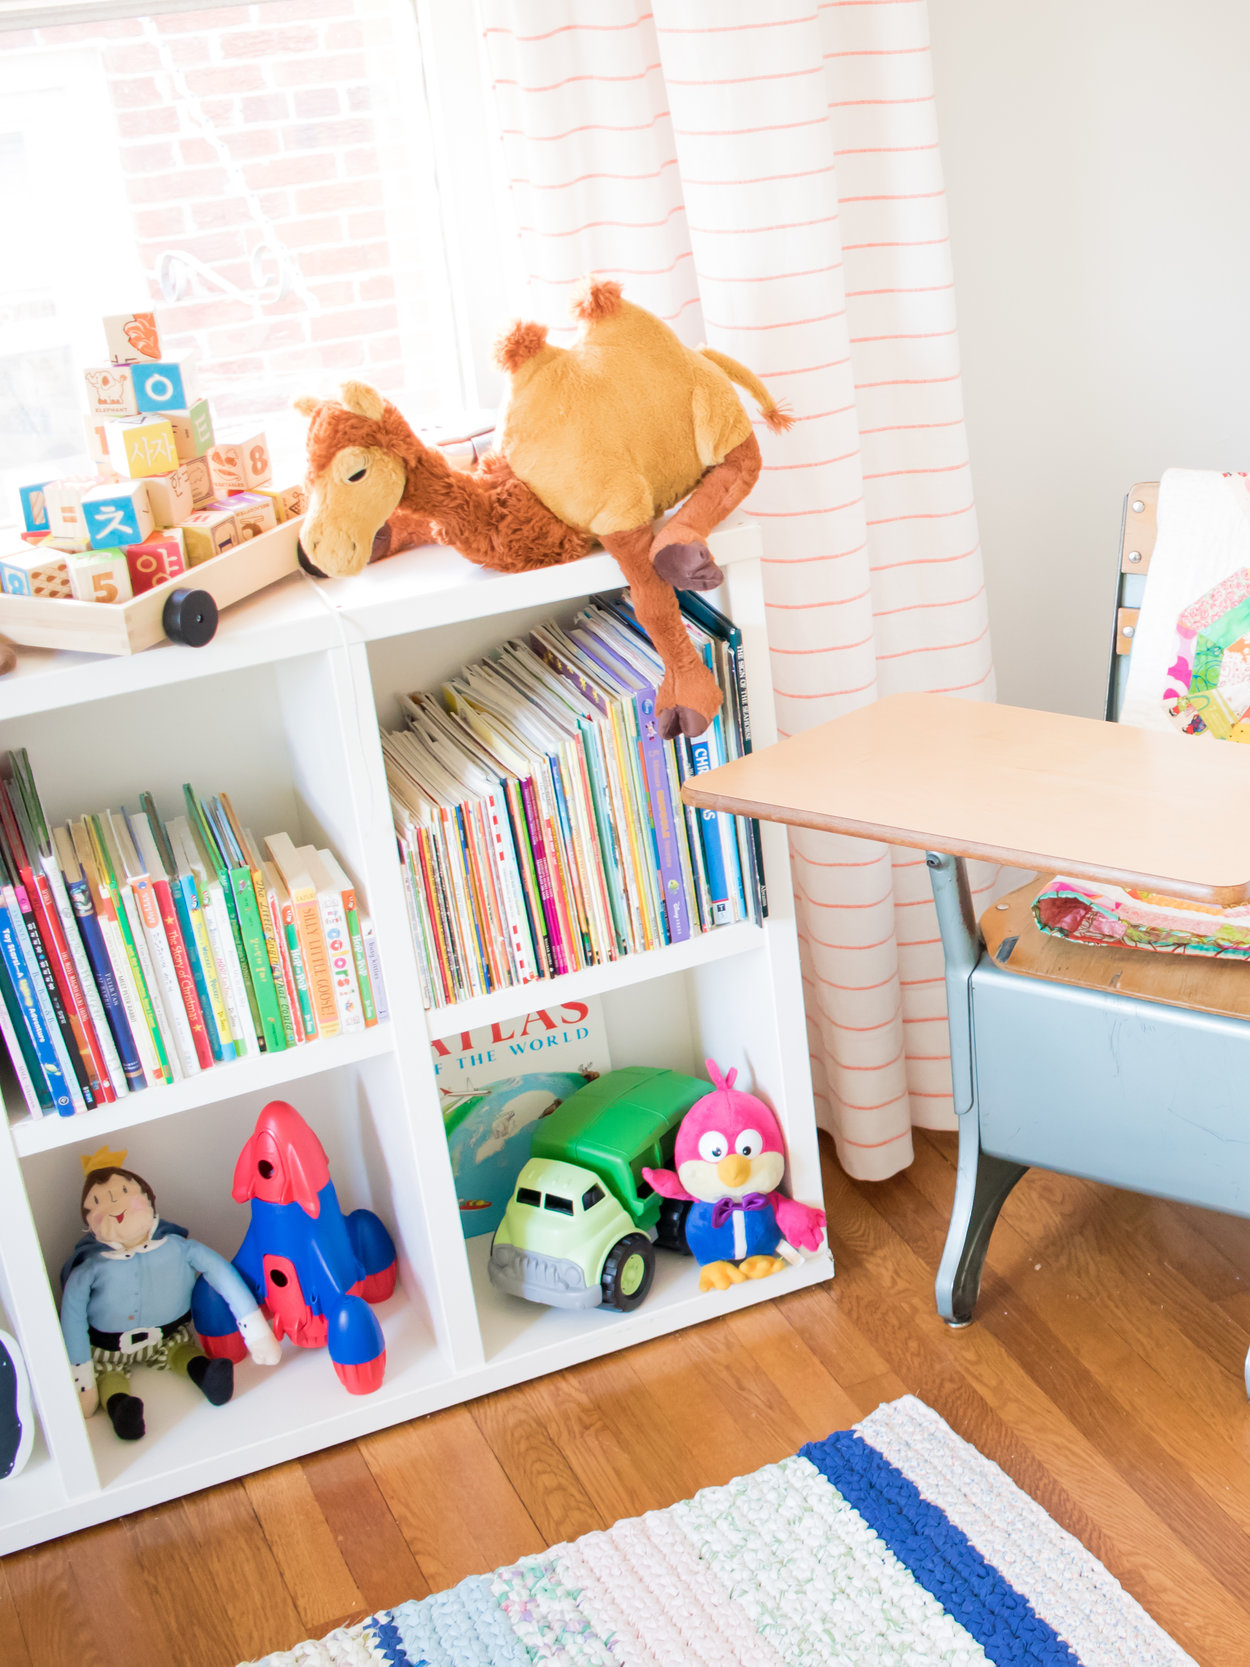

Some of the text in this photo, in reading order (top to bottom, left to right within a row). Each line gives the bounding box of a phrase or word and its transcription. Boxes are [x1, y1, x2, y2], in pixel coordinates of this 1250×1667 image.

[131, 432, 175, 467] 사자
[250, 445, 268, 476] 8
[92, 571, 118, 604] 5
[737, 660, 745, 677] SIGN
[739, 679, 746, 688] OF
[740, 705, 752, 740] SEAHORSE
[256, 880, 265, 898] The
[259, 901, 273, 932] Little
[167, 930, 179, 945] The
[367, 941, 376, 958] busy
[170, 944, 185, 969] Story
[303, 907, 337, 1017] SILLY LITTLE GOOSE!
[327, 927, 350, 986] colors
[103, 972, 119, 1006] PETER PAN
[178, 969, 188, 979] of
[180, 978, 200, 1021] Christmas
[28, 1006, 46, 1043] Adventure
[280, 1002, 293, 1031] Could
[456, 1050, 497, 1070] THE
[509, 1026, 589, 1056] WORLD
